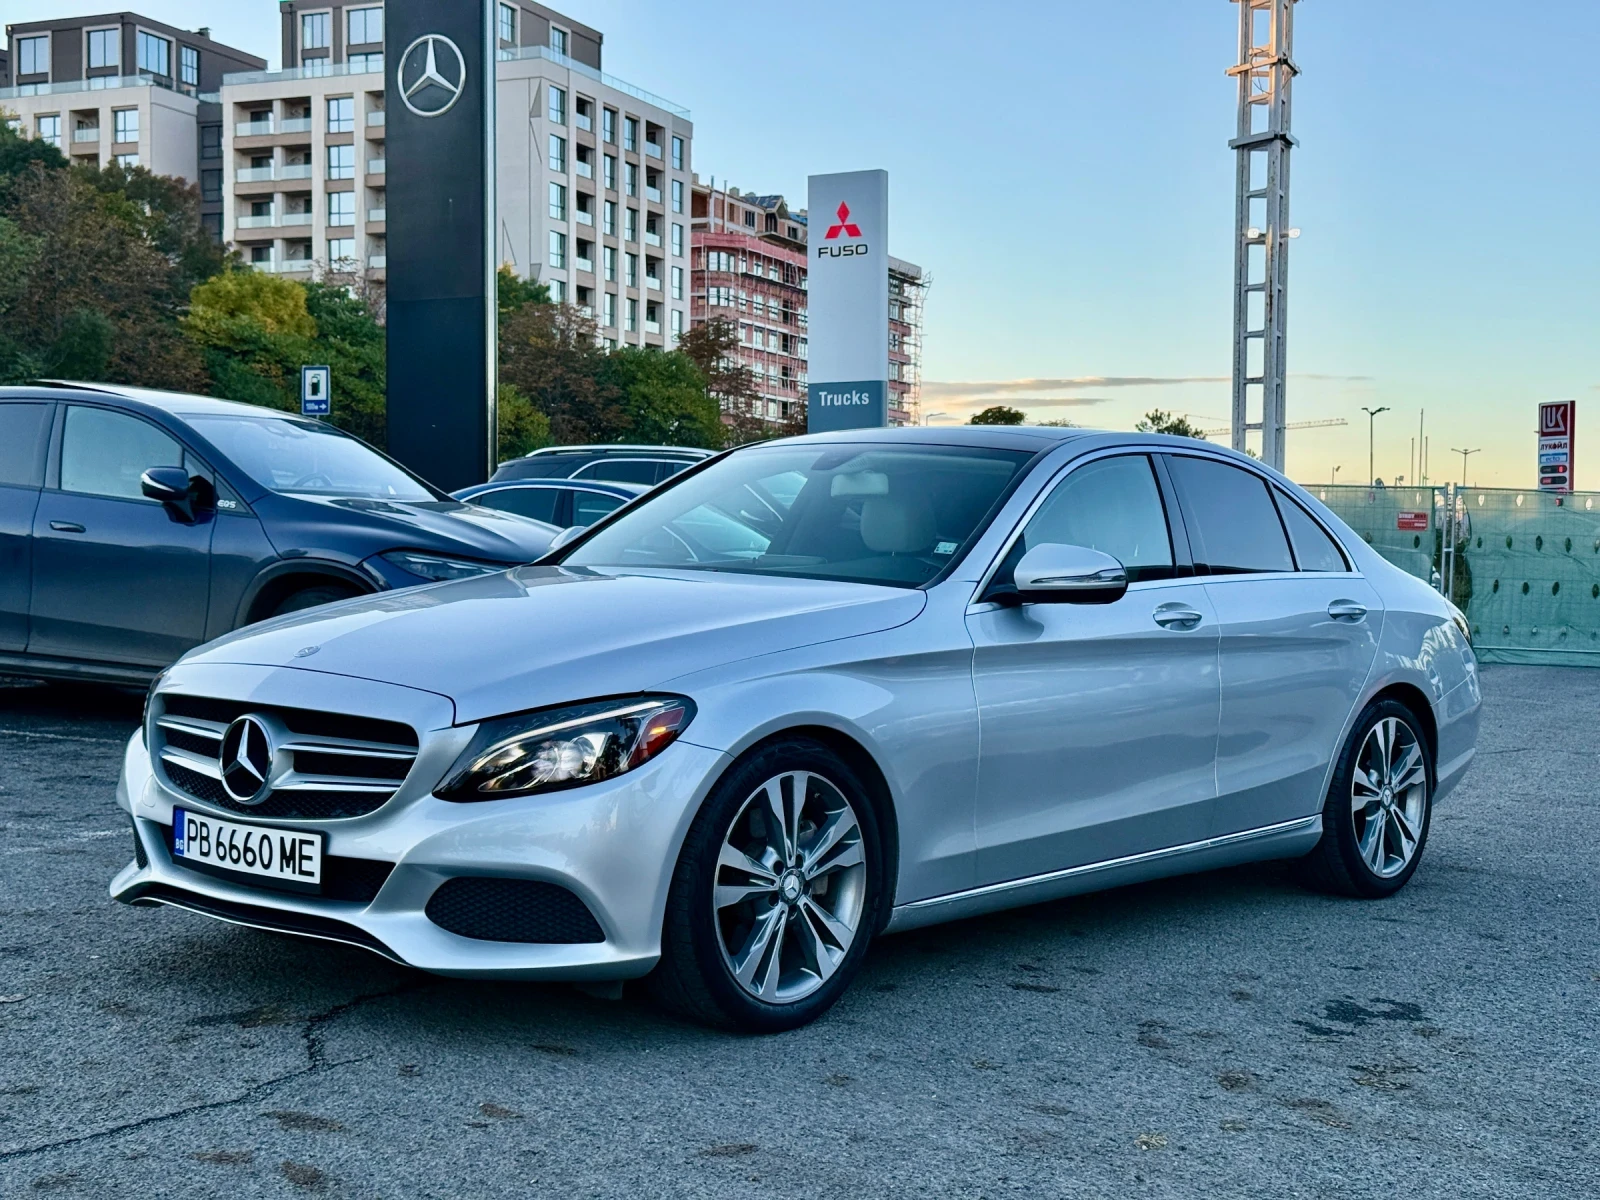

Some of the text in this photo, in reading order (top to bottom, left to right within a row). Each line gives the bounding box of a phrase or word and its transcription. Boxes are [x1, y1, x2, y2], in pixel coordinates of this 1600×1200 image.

[818, 244, 868, 258] FUSO
[819, 390, 869, 406] Trucks
[1541, 441, 1567, 450] ЛУКОЙЛ
[175, 838, 184, 850] BG
[187, 818, 315, 877] PB 6660 ME
